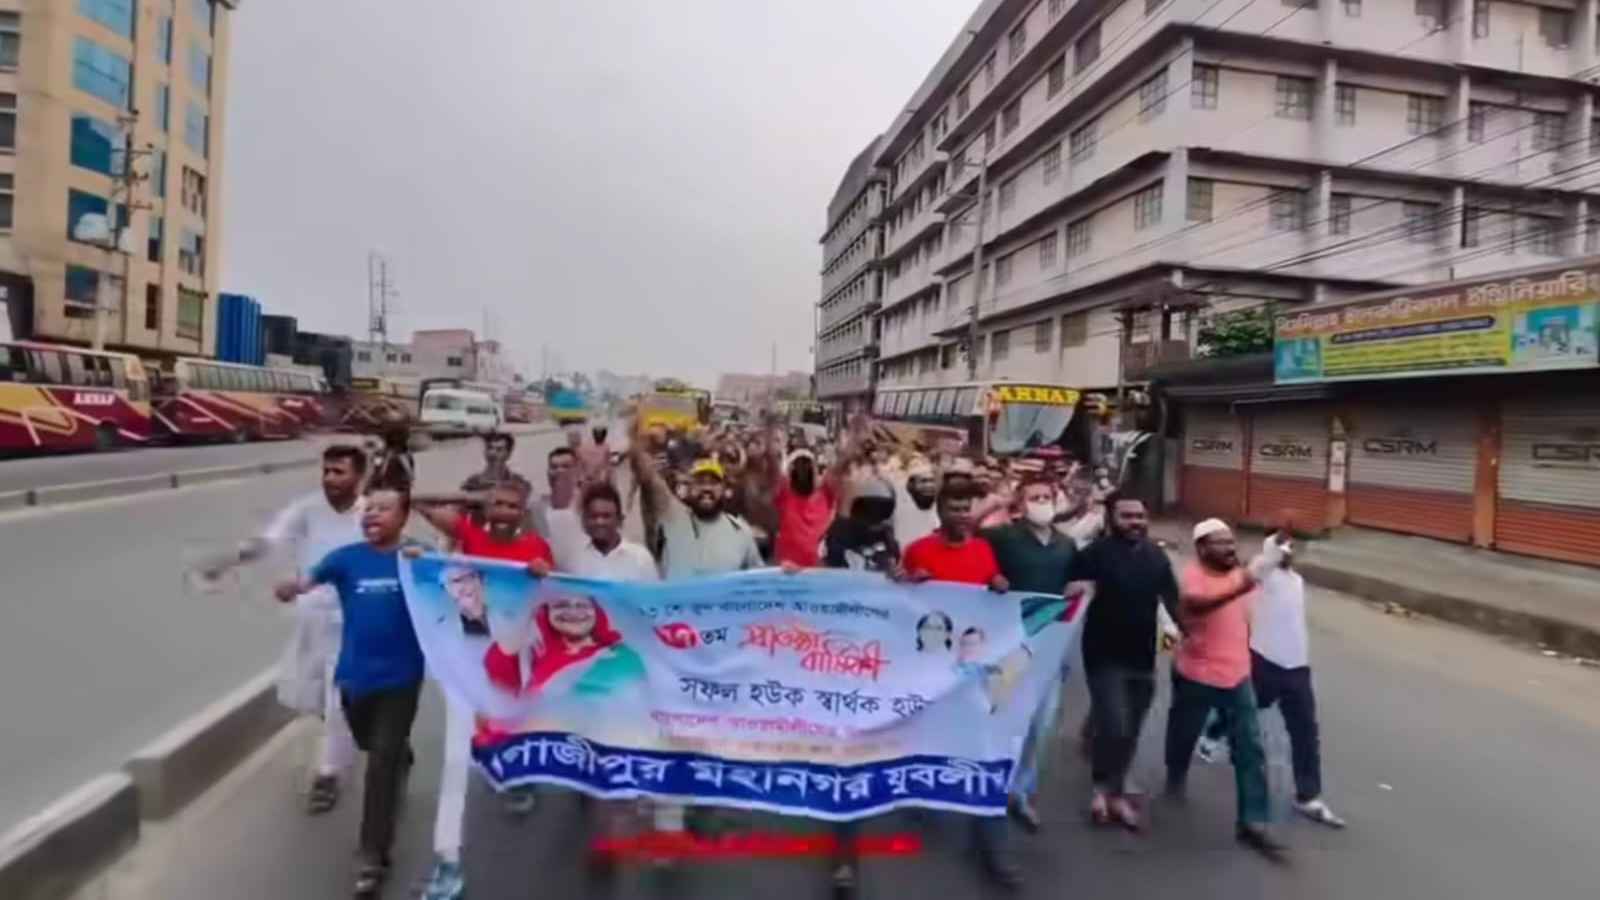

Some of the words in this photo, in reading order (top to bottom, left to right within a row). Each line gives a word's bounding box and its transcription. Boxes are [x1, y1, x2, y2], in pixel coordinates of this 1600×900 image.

[1191, 438, 1233, 452] CSRM
[1260, 443, 1313, 458] CSRM
[1363, 437, 1438, 456] CSRM
[679, 676, 741, 703] সফল
[749, 679, 807, 708] হউক
[688, 759, 874, 805] মহানগর
